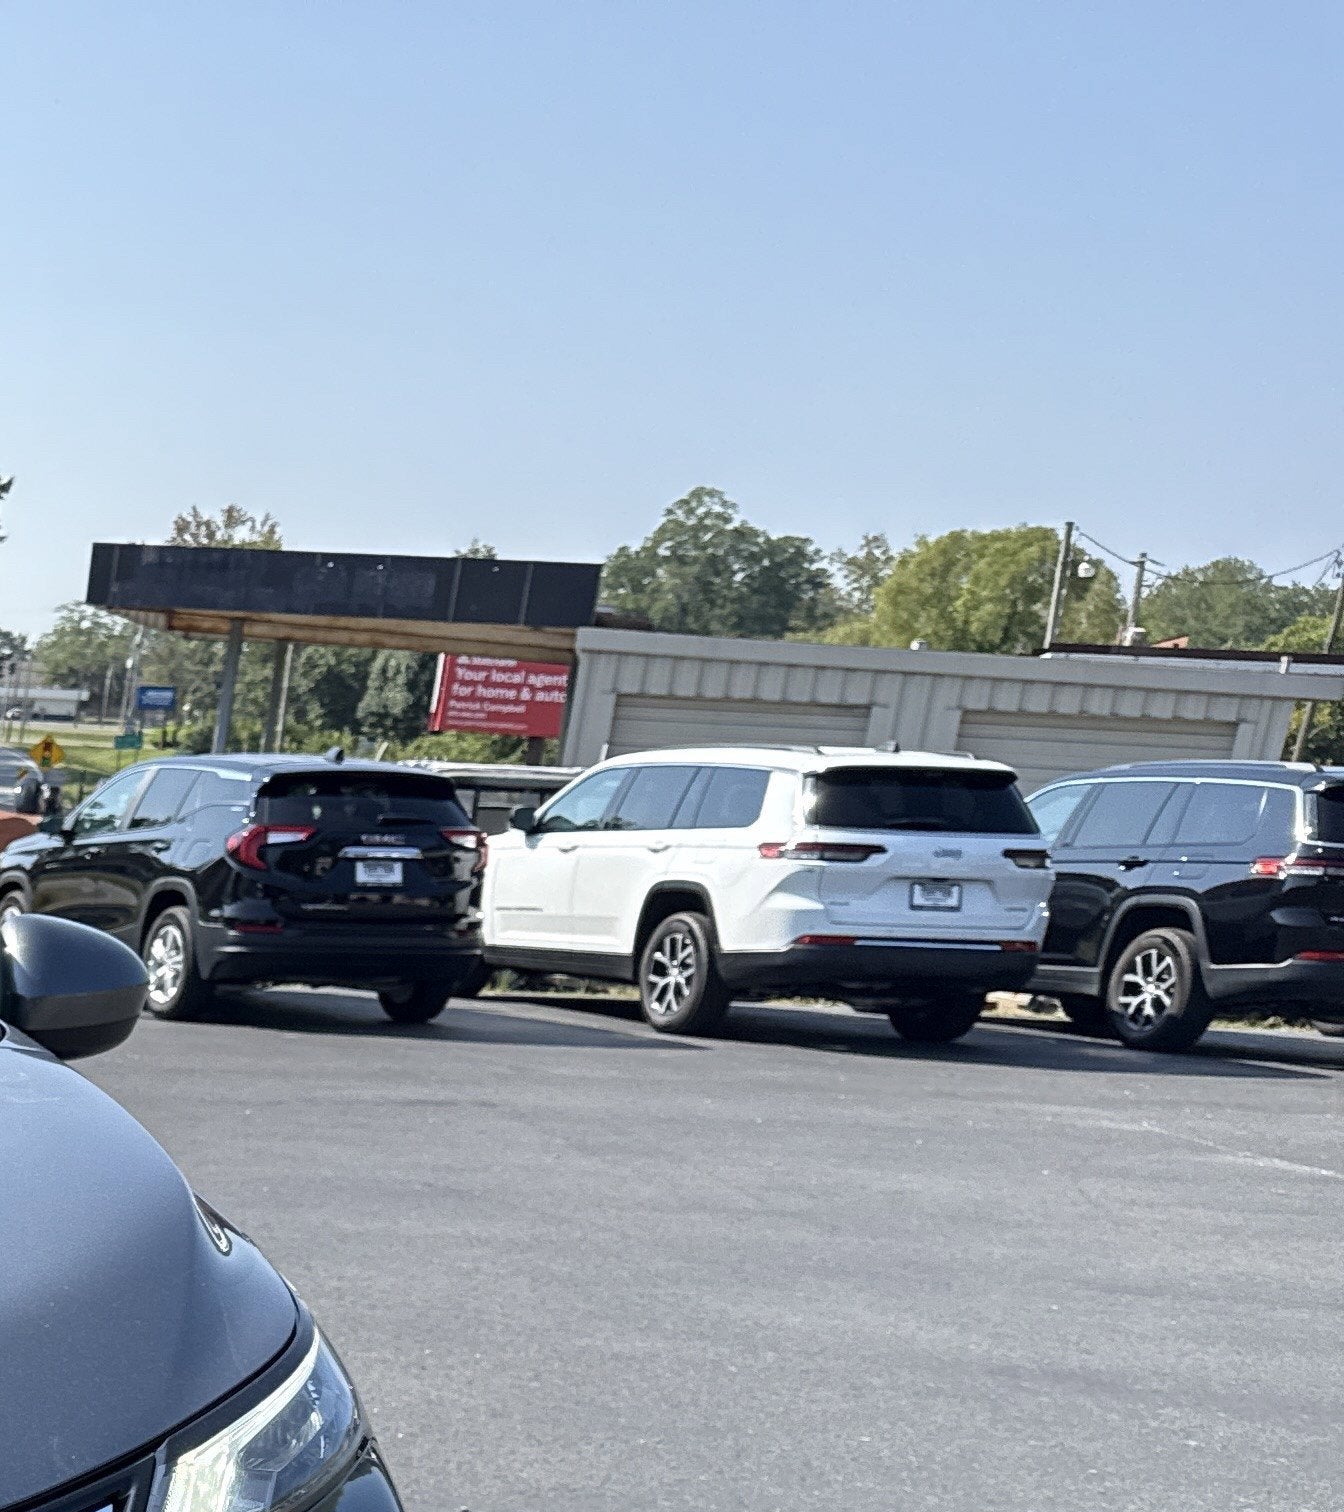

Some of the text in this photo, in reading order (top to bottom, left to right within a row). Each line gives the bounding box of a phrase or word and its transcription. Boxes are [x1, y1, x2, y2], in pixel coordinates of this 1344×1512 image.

[455, 666, 568, 688] Your local agent
[452, 682, 474, 697] for
[475, 684, 518, 699] home
[519, 686, 533, 701] &
